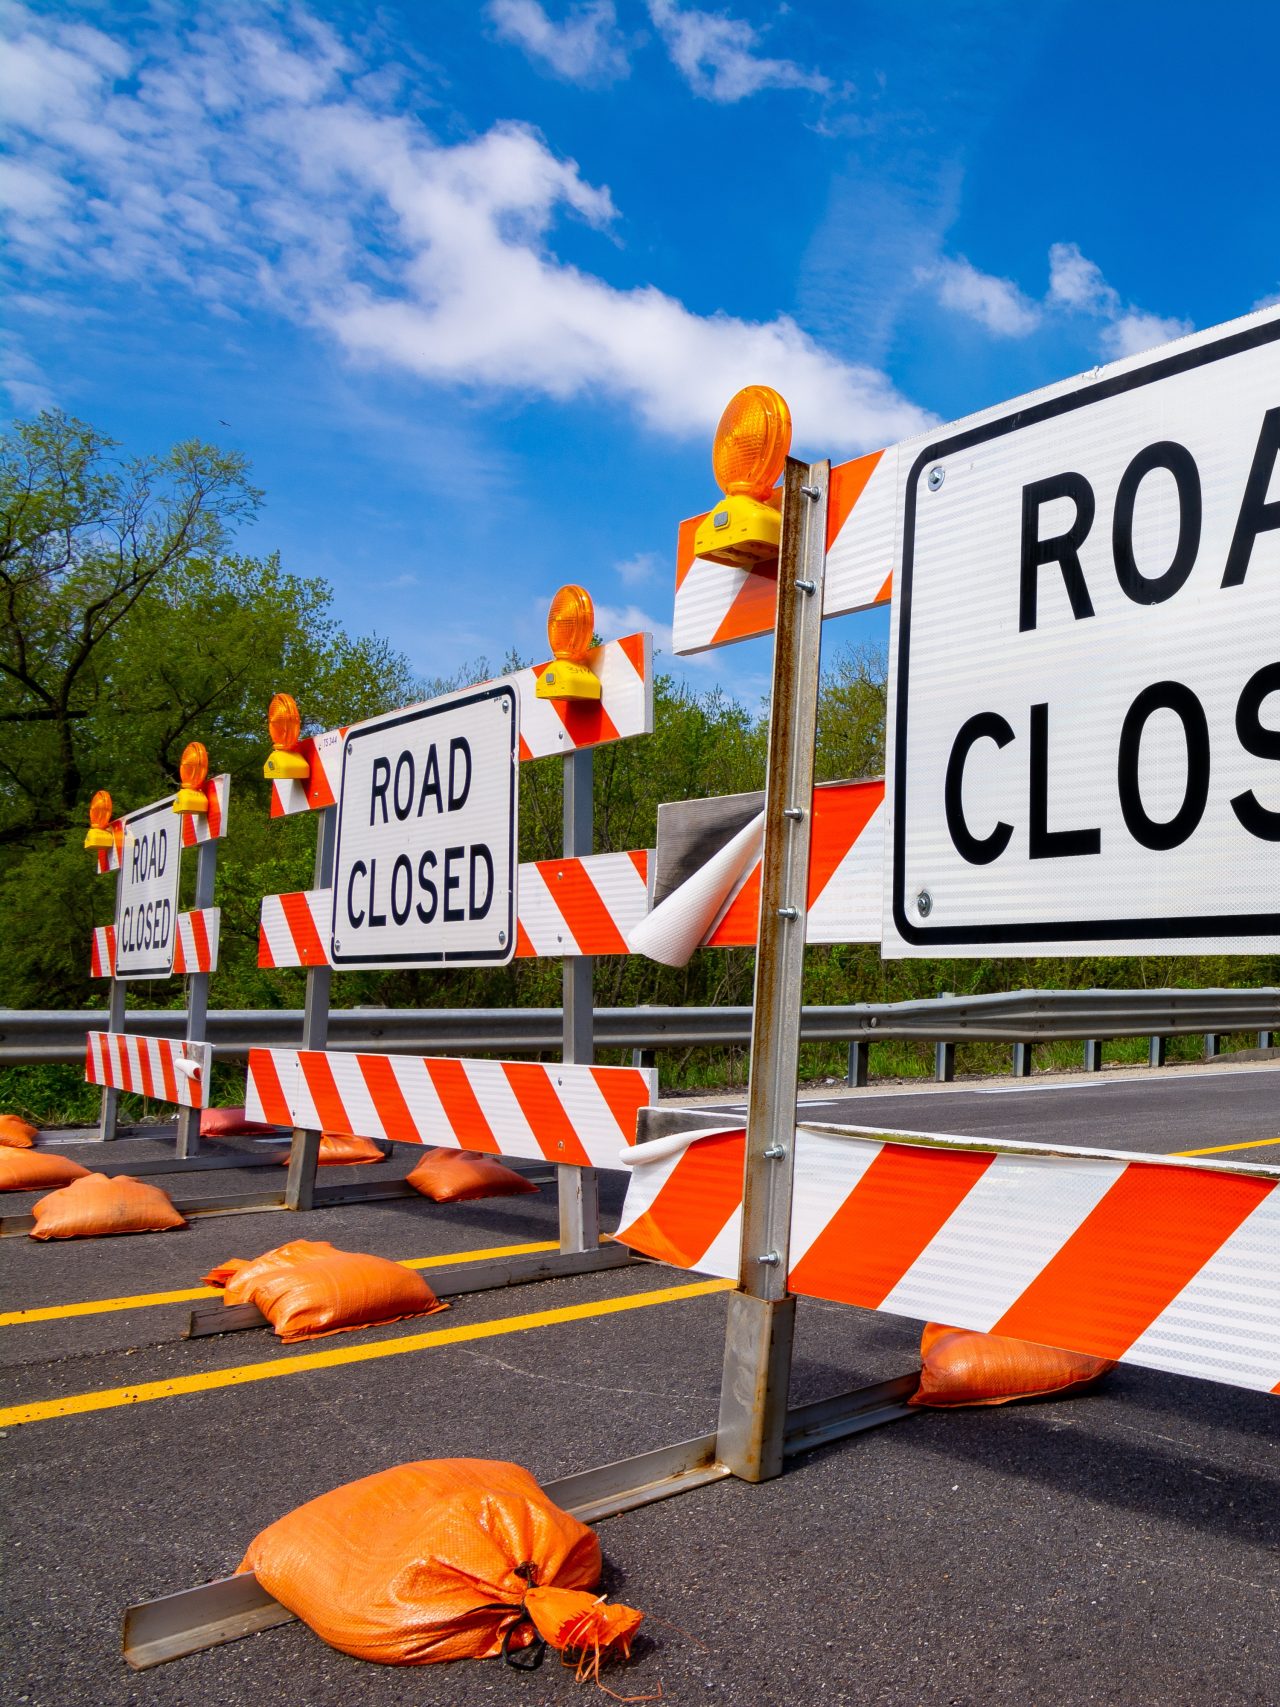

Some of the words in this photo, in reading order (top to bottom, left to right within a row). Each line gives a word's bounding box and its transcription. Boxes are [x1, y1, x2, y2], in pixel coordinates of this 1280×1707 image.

[370, 736, 472, 827] ROAD
[132, 828, 168, 883] ROAD
[347, 843, 495, 929] CLOSED
[121, 898, 171, 953] CLOSED
